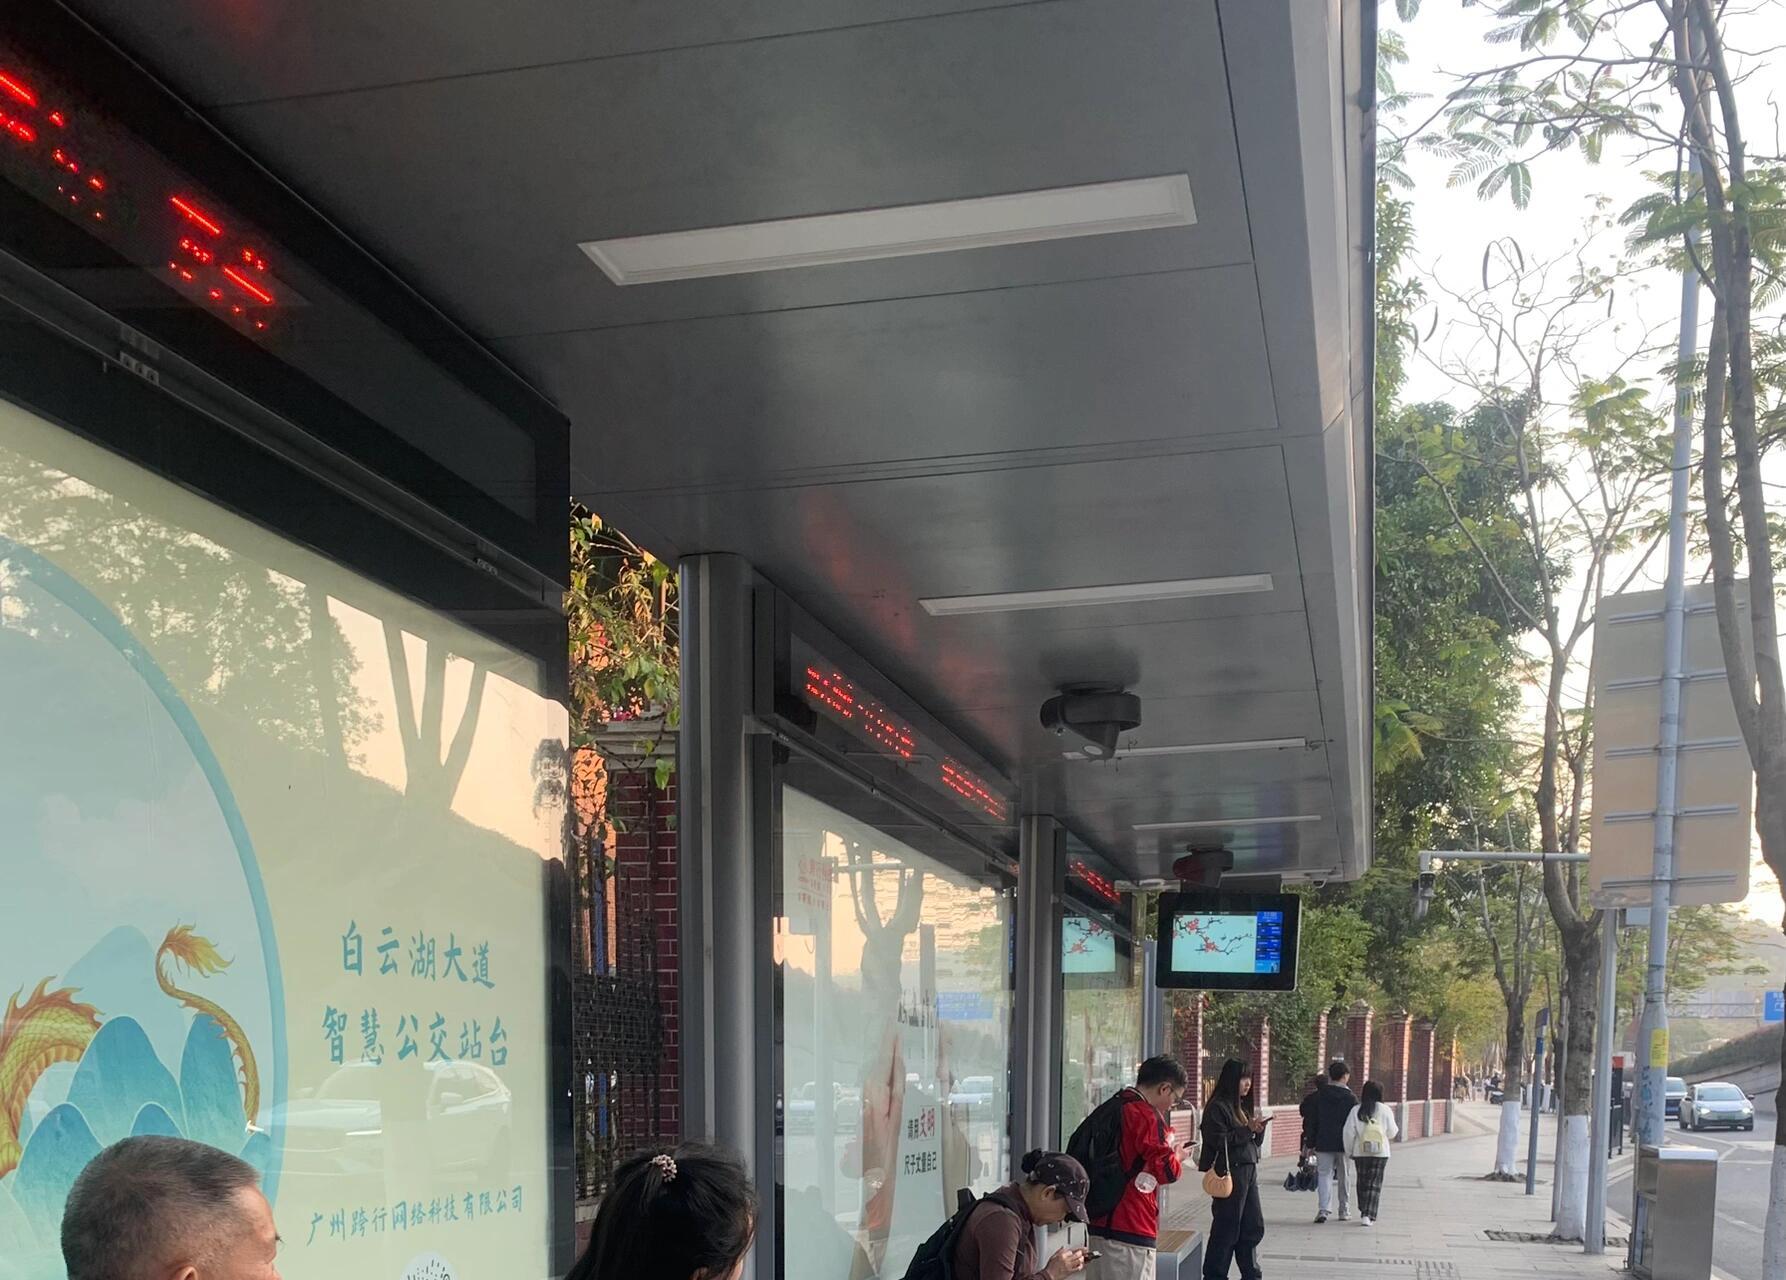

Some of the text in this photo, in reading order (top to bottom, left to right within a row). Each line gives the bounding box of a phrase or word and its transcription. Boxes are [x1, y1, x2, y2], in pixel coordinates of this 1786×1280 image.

[342, 920, 495, 989] 白云湖大道
[321, 1004, 508, 1065] 智慧公交站台
[306, 1185, 523, 1247] 广州跨行网络科技有限公司
